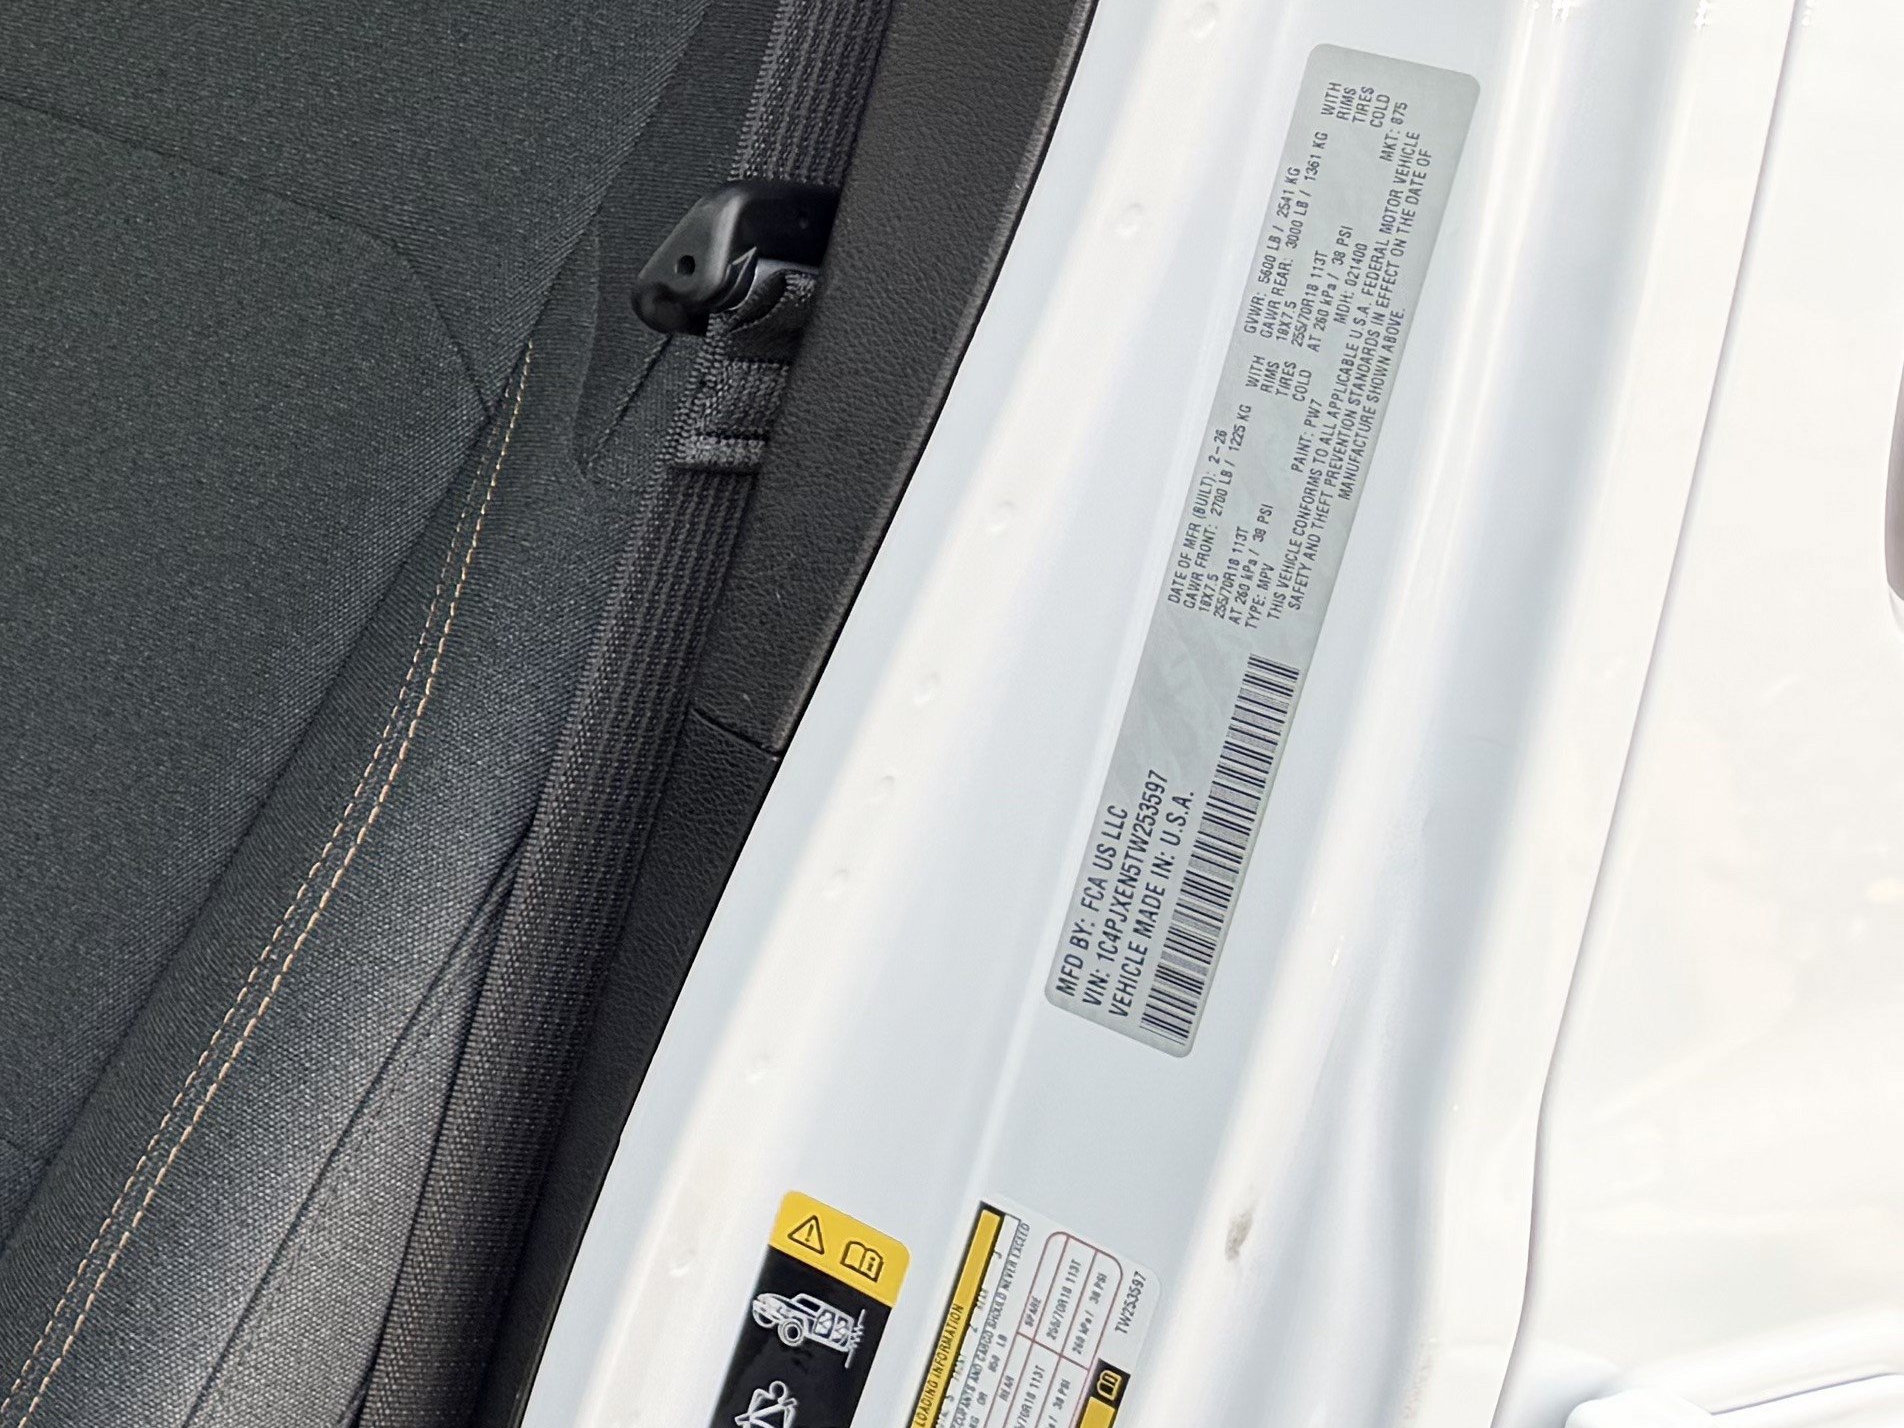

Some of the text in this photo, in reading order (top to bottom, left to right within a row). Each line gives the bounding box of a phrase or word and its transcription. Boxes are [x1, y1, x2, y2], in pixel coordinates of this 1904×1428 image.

[1335, 86, 1357, 121] RIMS
[1378, 101, 1408, 162] MKT: 875
[1309, 249, 1328, 278] 113T
[1351, 85, 1375, 123] TIRES
[1392, 131, 1421, 184] VEHICLE
[1259, 81, 1342, 339] GAWR REAR: 3000 LB 1361 KG WITH
[1306, 333, 1322, 353] AT
[1335, 225, 1353, 247] PSI
[1368, 93, 1391, 128] COLD
[1378, 188, 1404, 235] MOTOR
[1243, 166, 1301, 334] GVWR: 5600 LB 2541 KG
[1332, 242, 1368, 325] MDH: 021400
[1360, 239, 1390, 297] FEDERAL
[1259, 360, 1280, 394] RIMS
[1287, 148, 1432, 611] SAFETY AND THEFT PREVENTION STANDARDS IN EFFECT ON THE DATE OF
[1325, 342, 1360, 420] APPLICABLE
[1337, 309, 1405, 501] MANUFACTURE SHOWN ABOVE.
[1231, 525, 1249, 554] 113T
[1274, 360, 1297, 396] TIRES
[1290, 397, 1322, 473] PAINT: PW7
[1311, 447, 1329, 465] TO
[1318, 423, 1338, 446] ALL
[1182, 354, 1266, 609] GAWR FRONT: 2700 LB 1225 KG WITH
[1227, 605, 1243, 625] AT
[1256, 503, 1274, 525] PSI
[1291, 368, 1313, 402] COLD
[1291, 467, 1323, 537] CONFORMS
[1177, 551, 1192, 569] OF
[1182, 521, 1202, 550] MFR
[1275, 537, 1303, 589] VEHICLE
[1166, 570, 1188, 604] DATE
[1243, 562, 1275, 629] TYPE: MPV
[1266, 591, 1287, 620] THIS
[1055, 804, 1128, 997] MFD BY: FCA US LLC
[1081, 768, 1168, 1006] VIN: 1C4PJXEN5TW253597
[1107, 791, 1194, 1017] VEHICLE MADE IN: U.S.A.
[1113, 1270, 1146, 1334] TW253597
[914, 1378, 939, 1428] LOADING
[931, 1302, 965, 1379] INFORMATION
